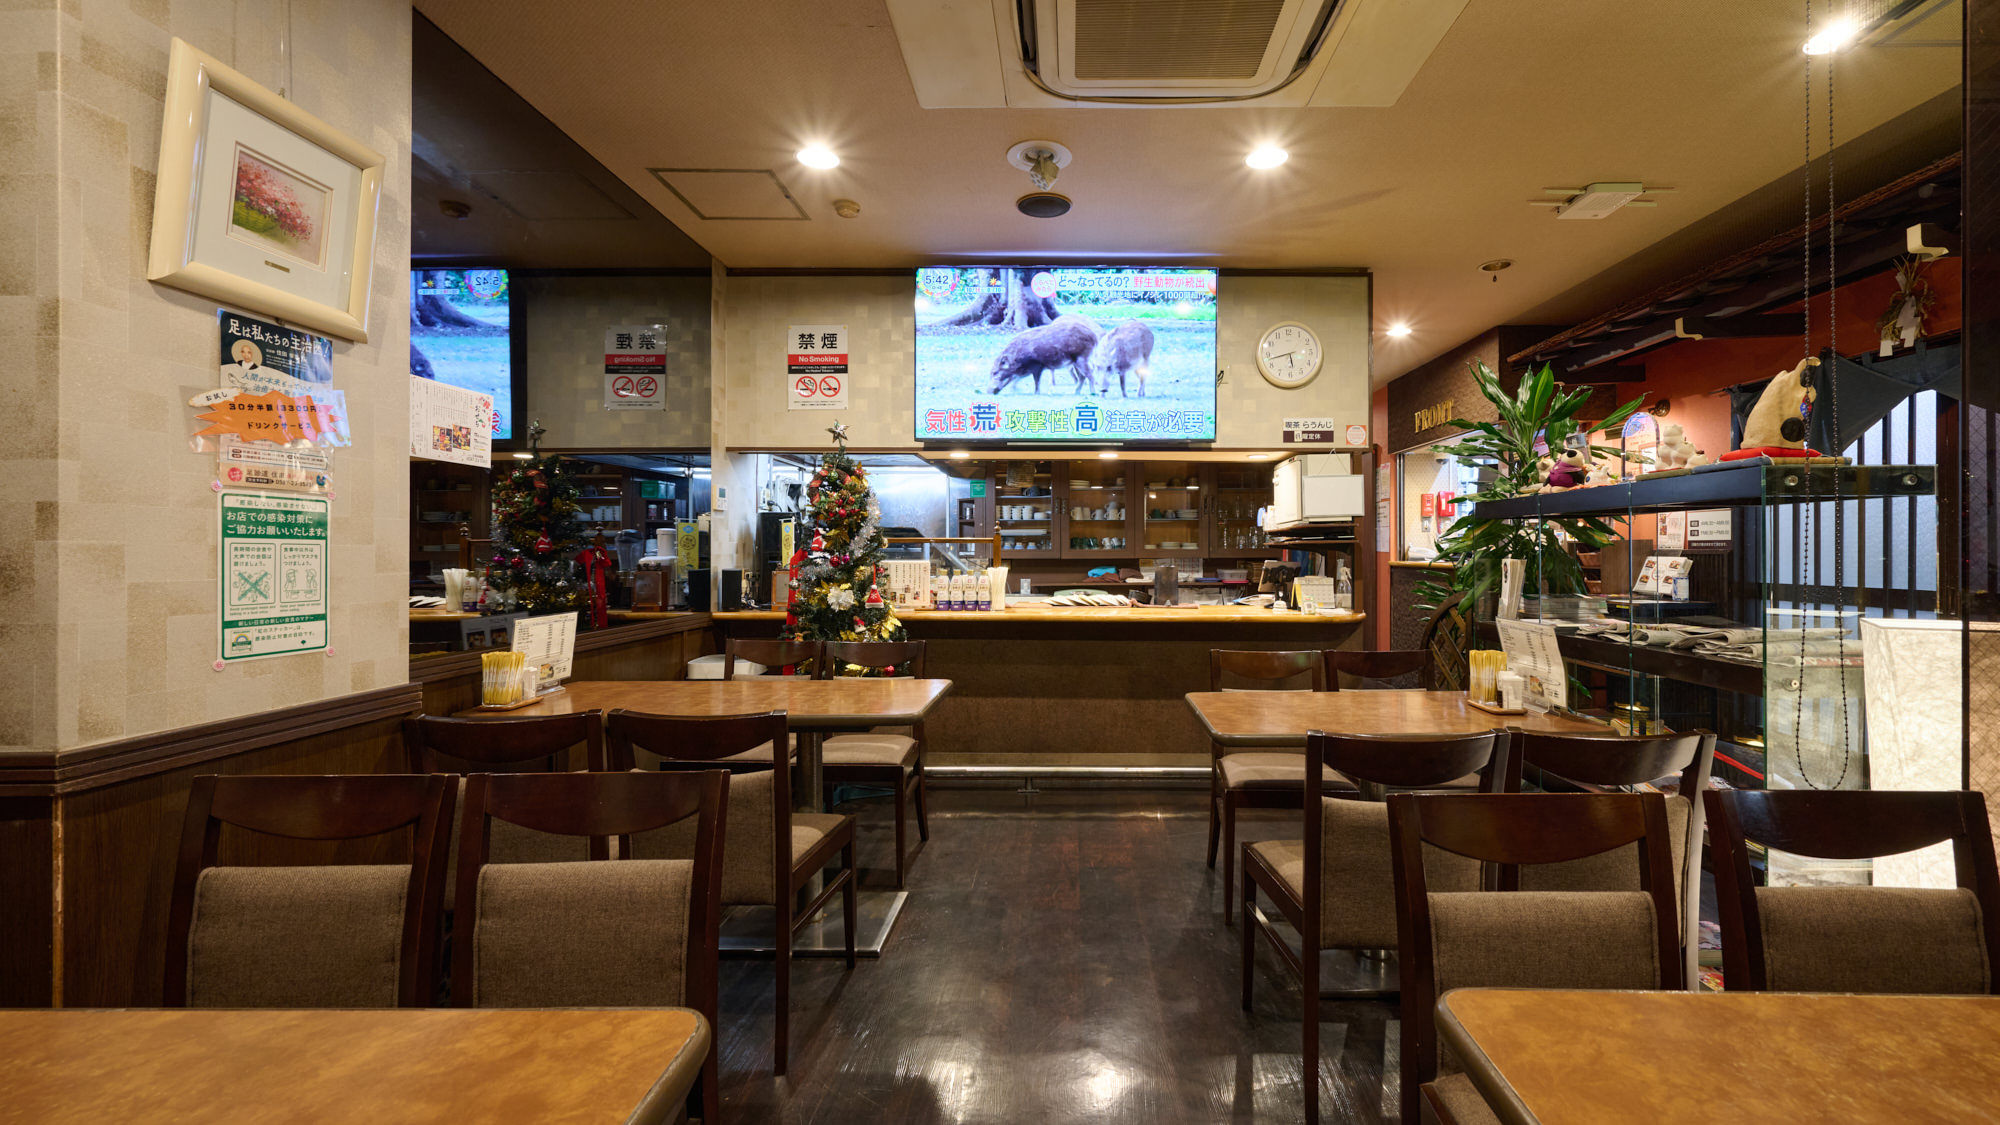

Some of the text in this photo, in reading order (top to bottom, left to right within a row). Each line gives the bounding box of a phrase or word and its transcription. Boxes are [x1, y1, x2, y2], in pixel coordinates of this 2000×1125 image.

[925, 275, 949, 285] 5:42
[1133, 276, 1206, 289] 野生動物が続出
[798, 333, 838, 350] 禁煙
[809, 356, 840, 364] Smoking
[1104, 409, 1206, 434] 注意が必要
[1414, 399, 1454, 433] FRONT
[247, 422, 313, 430] ドリンクサービス
[1302, 420, 1333, 429] らうんじ
[226, 511, 313, 524] お店での感染対策に
[226, 524, 326, 537] ご協力お願いいたします。
